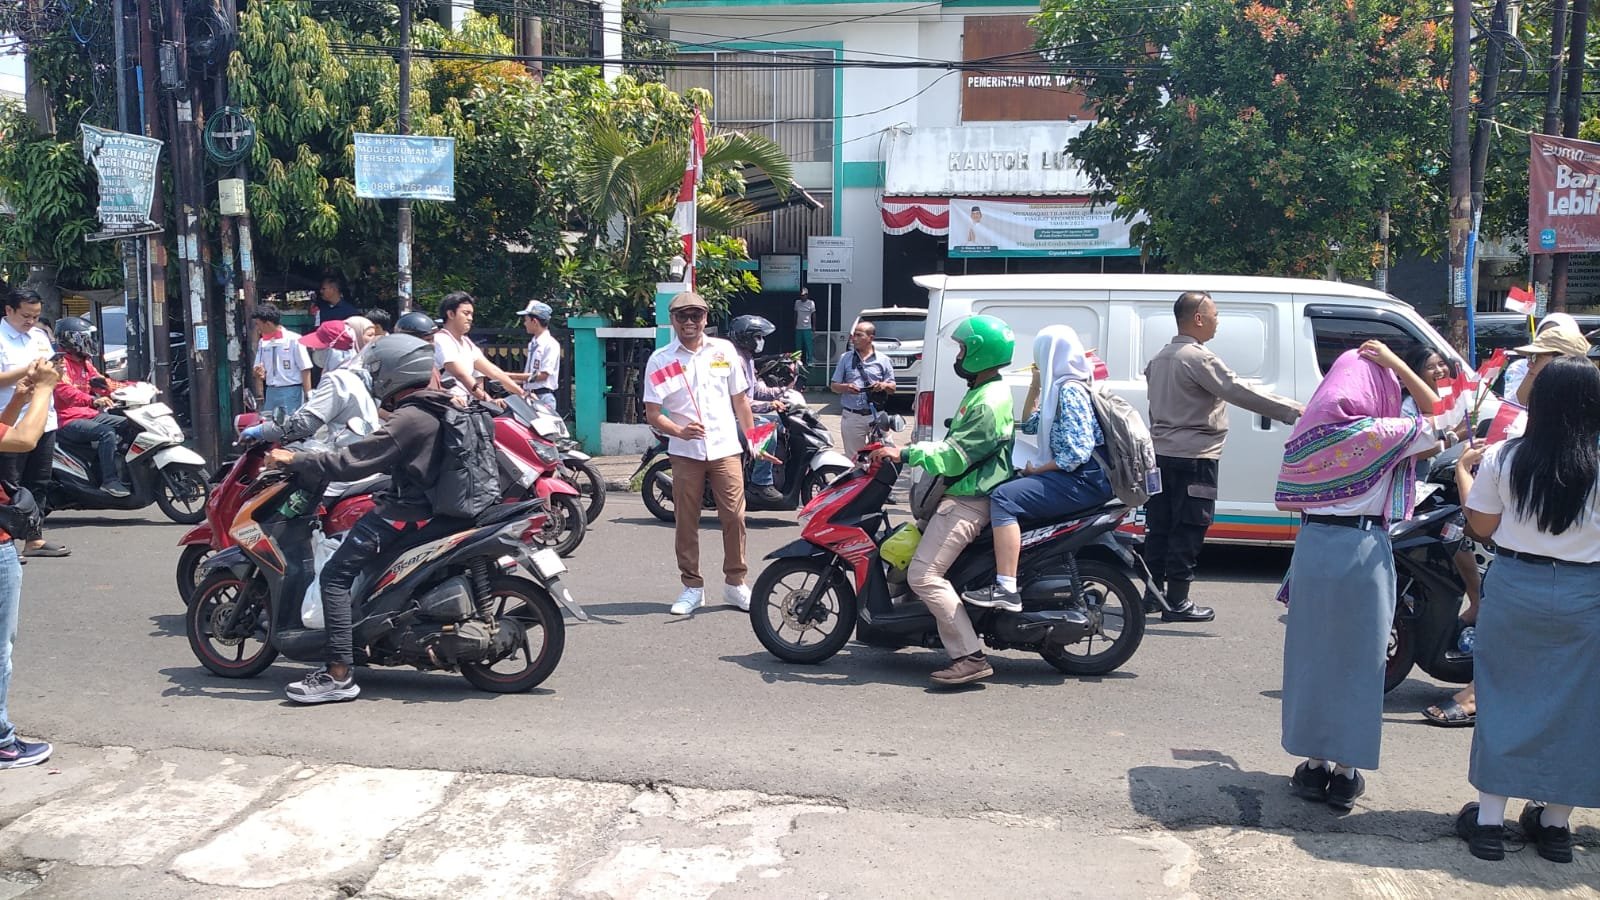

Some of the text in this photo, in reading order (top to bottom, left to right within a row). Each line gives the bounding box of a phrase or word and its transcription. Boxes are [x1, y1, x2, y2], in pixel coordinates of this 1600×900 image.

[968, 76, 1025, 88] PEMERINTAH
[1028, 75, 1052, 87] KOTA
[357, 145, 428, 156] MODEL RUMAH
[359, 154, 408, 163] TERSERAH
[948, 151, 1079, 171] KANTOR LUR
